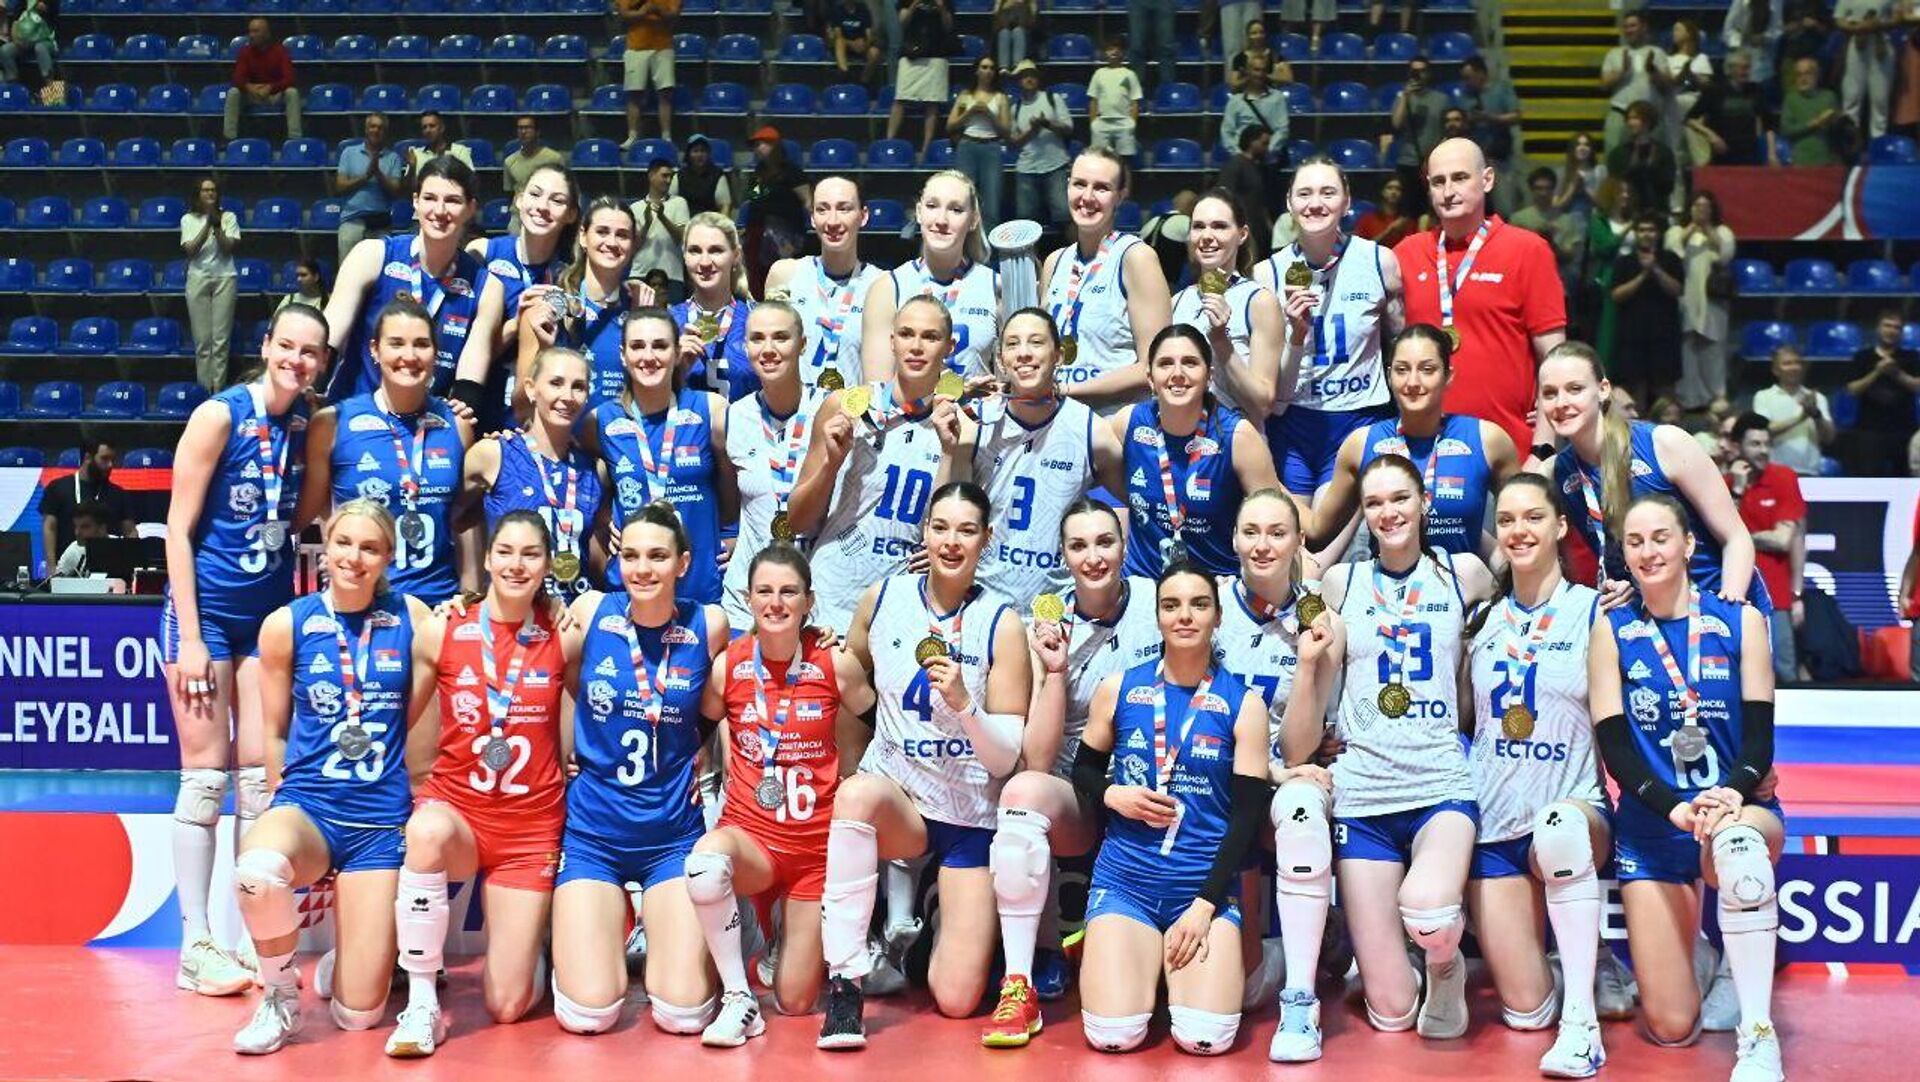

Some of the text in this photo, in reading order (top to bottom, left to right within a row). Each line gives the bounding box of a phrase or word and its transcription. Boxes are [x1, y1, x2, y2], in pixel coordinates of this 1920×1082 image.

[1312, 313, 1349, 366] 11
[1311, 374, 1371, 396] ECTOS
[1050, 460, 1073, 471] ВФВ
[874, 464, 933, 525] 10
[1008, 476, 1036, 531] 3
[395, 514, 434, 569] 19
[999, 544, 1063, 569] ECTOS
[903, 669, 933, 722] 4
[1404, 700, 1451, 719] CTO
[1491, 661, 1538, 721] 21
[468, 735, 531, 794] 32
[617, 729, 649, 786] 3
[778, 740, 822, 750] ОШТАНСКА
[904, 738, 973, 759] ECTOS
[1495, 738, 1567, 762] ECTOS
[776, 765, 817, 823] 16
[1159, 802, 1186, 856] 7
